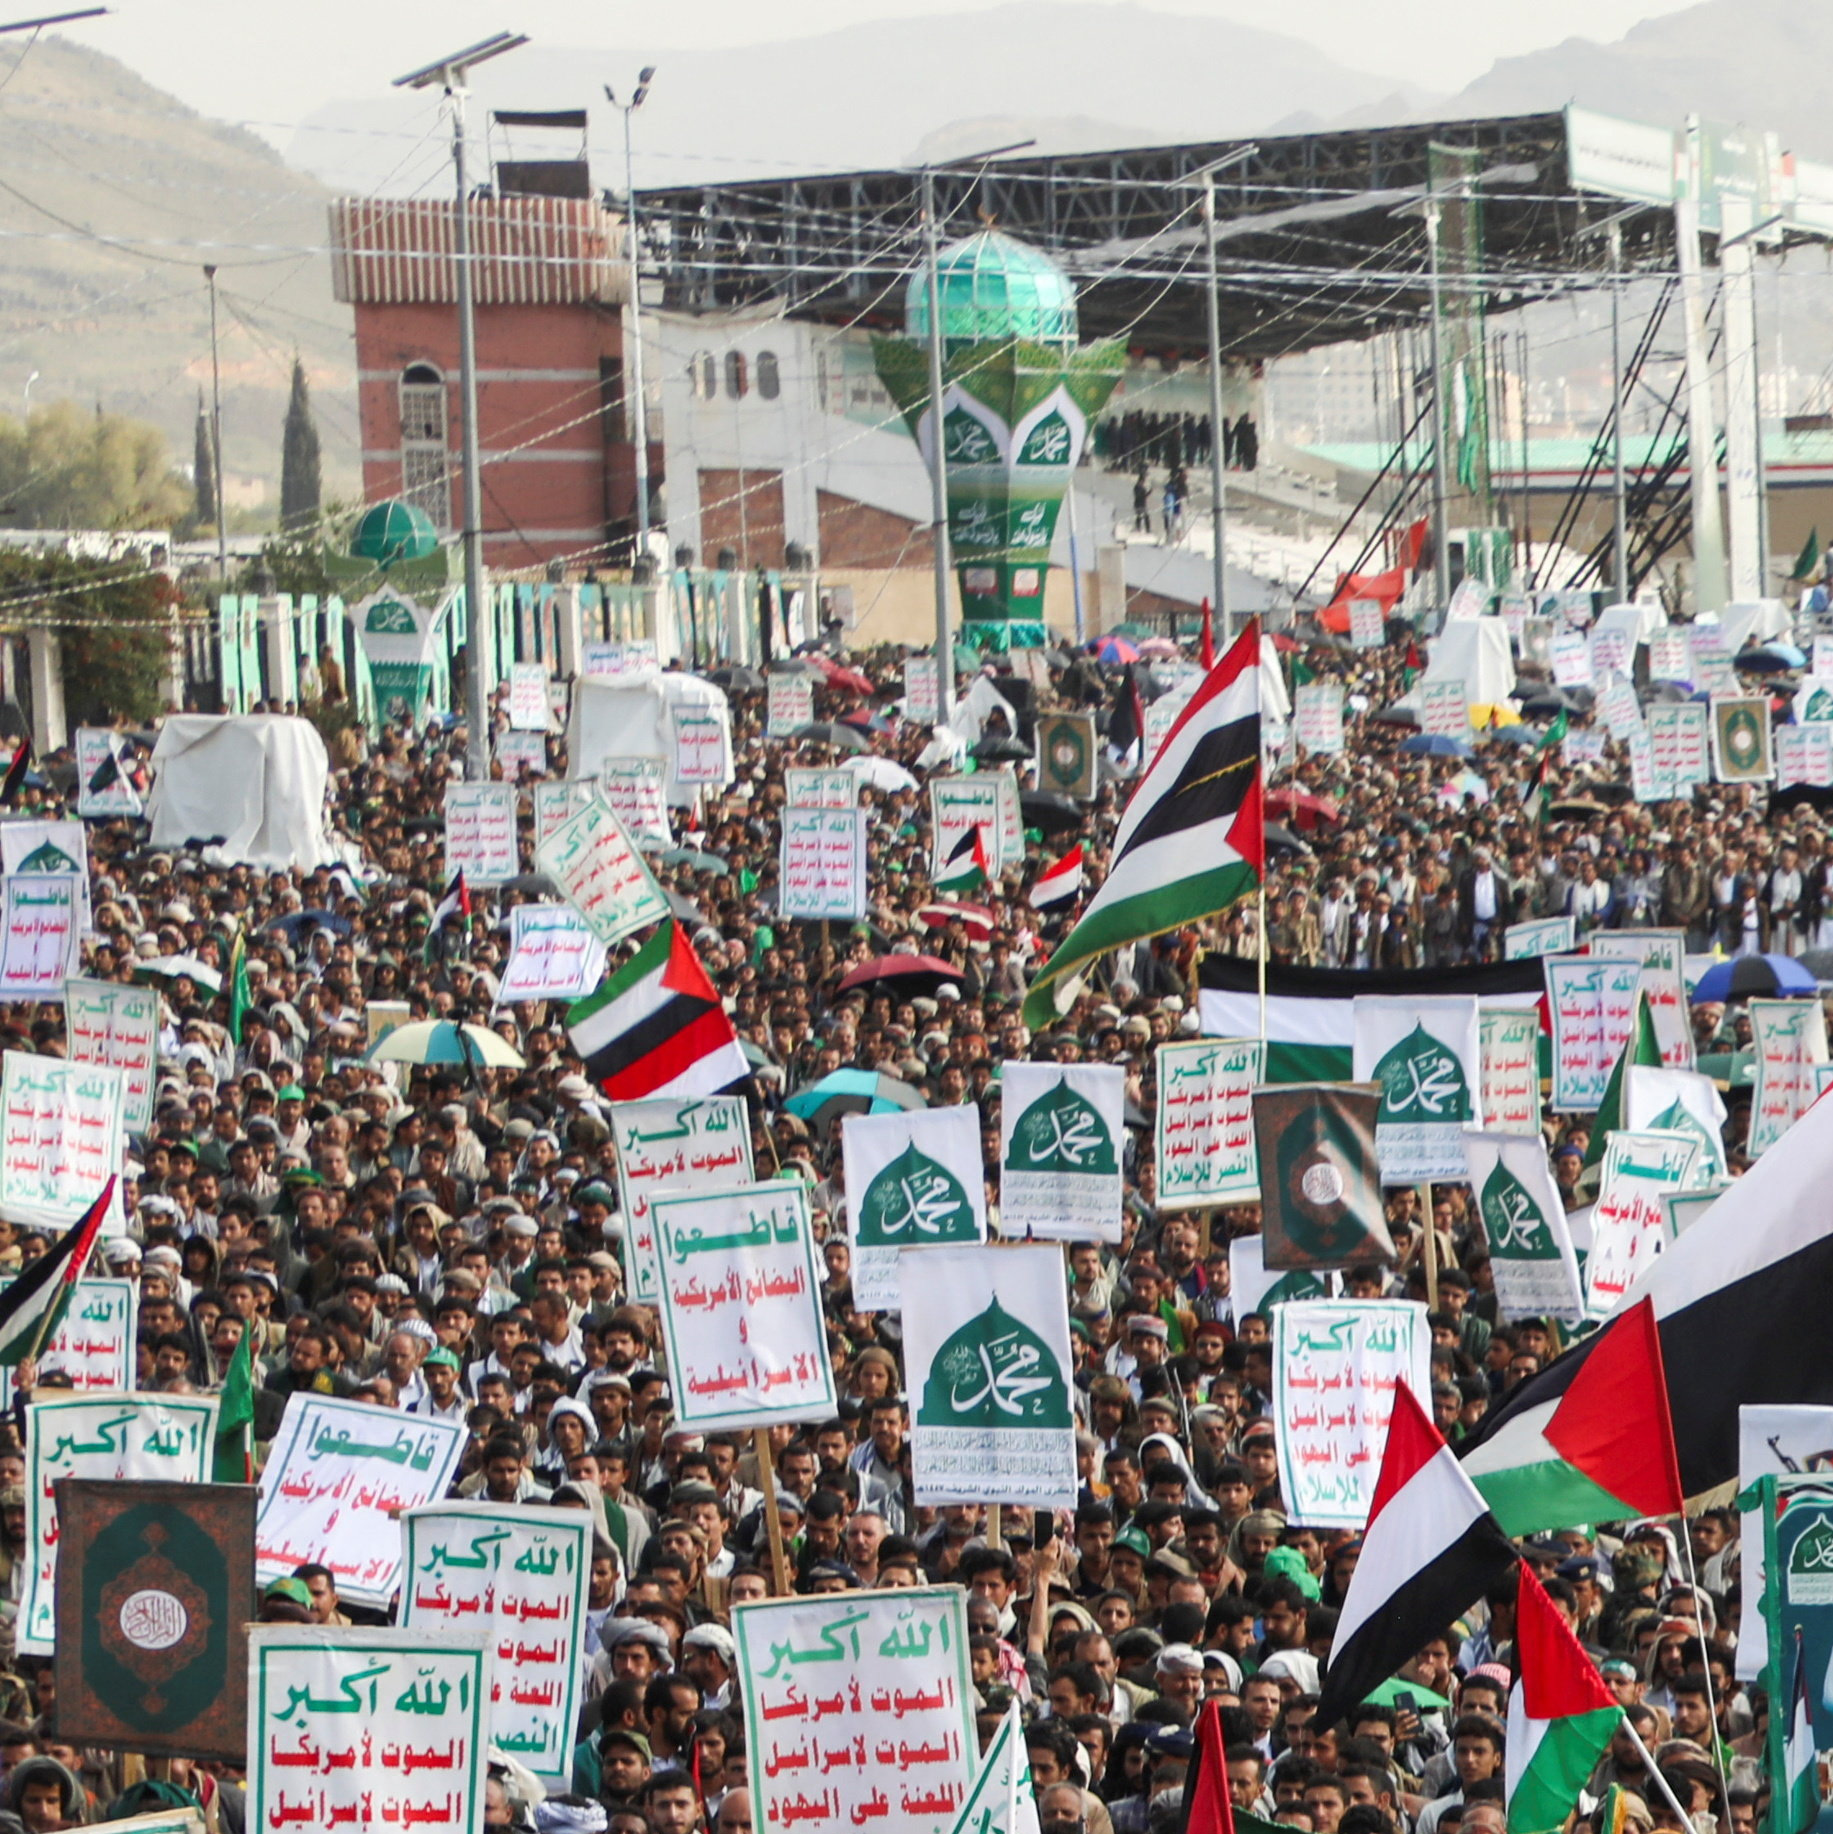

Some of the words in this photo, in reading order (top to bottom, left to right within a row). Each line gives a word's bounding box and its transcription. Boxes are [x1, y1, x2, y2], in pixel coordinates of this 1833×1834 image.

[665, 1210, 798, 1264] قاطعوا
[675, 1270, 741, 1310] الأمريكية
[747, 1269, 804, 1304] البضائع
[740, 1319, 748, 1344] و
[688, 1355, 817, 1397] الإسرائيلية
[760, 1612, 869, 1678] أكبر
[878, 1613, 950, 1658] الله
[272, 1665, 387, 1720] أكبر
[395, 1667, 469, 1717] الله
[272, 1735, 372, 1775] لأمريكا
[382, 1740, 464, 1775] الموت
[270, 1792, 372, 1830] لإسرائيل
[382, 1791, 461, 1829] الموت
